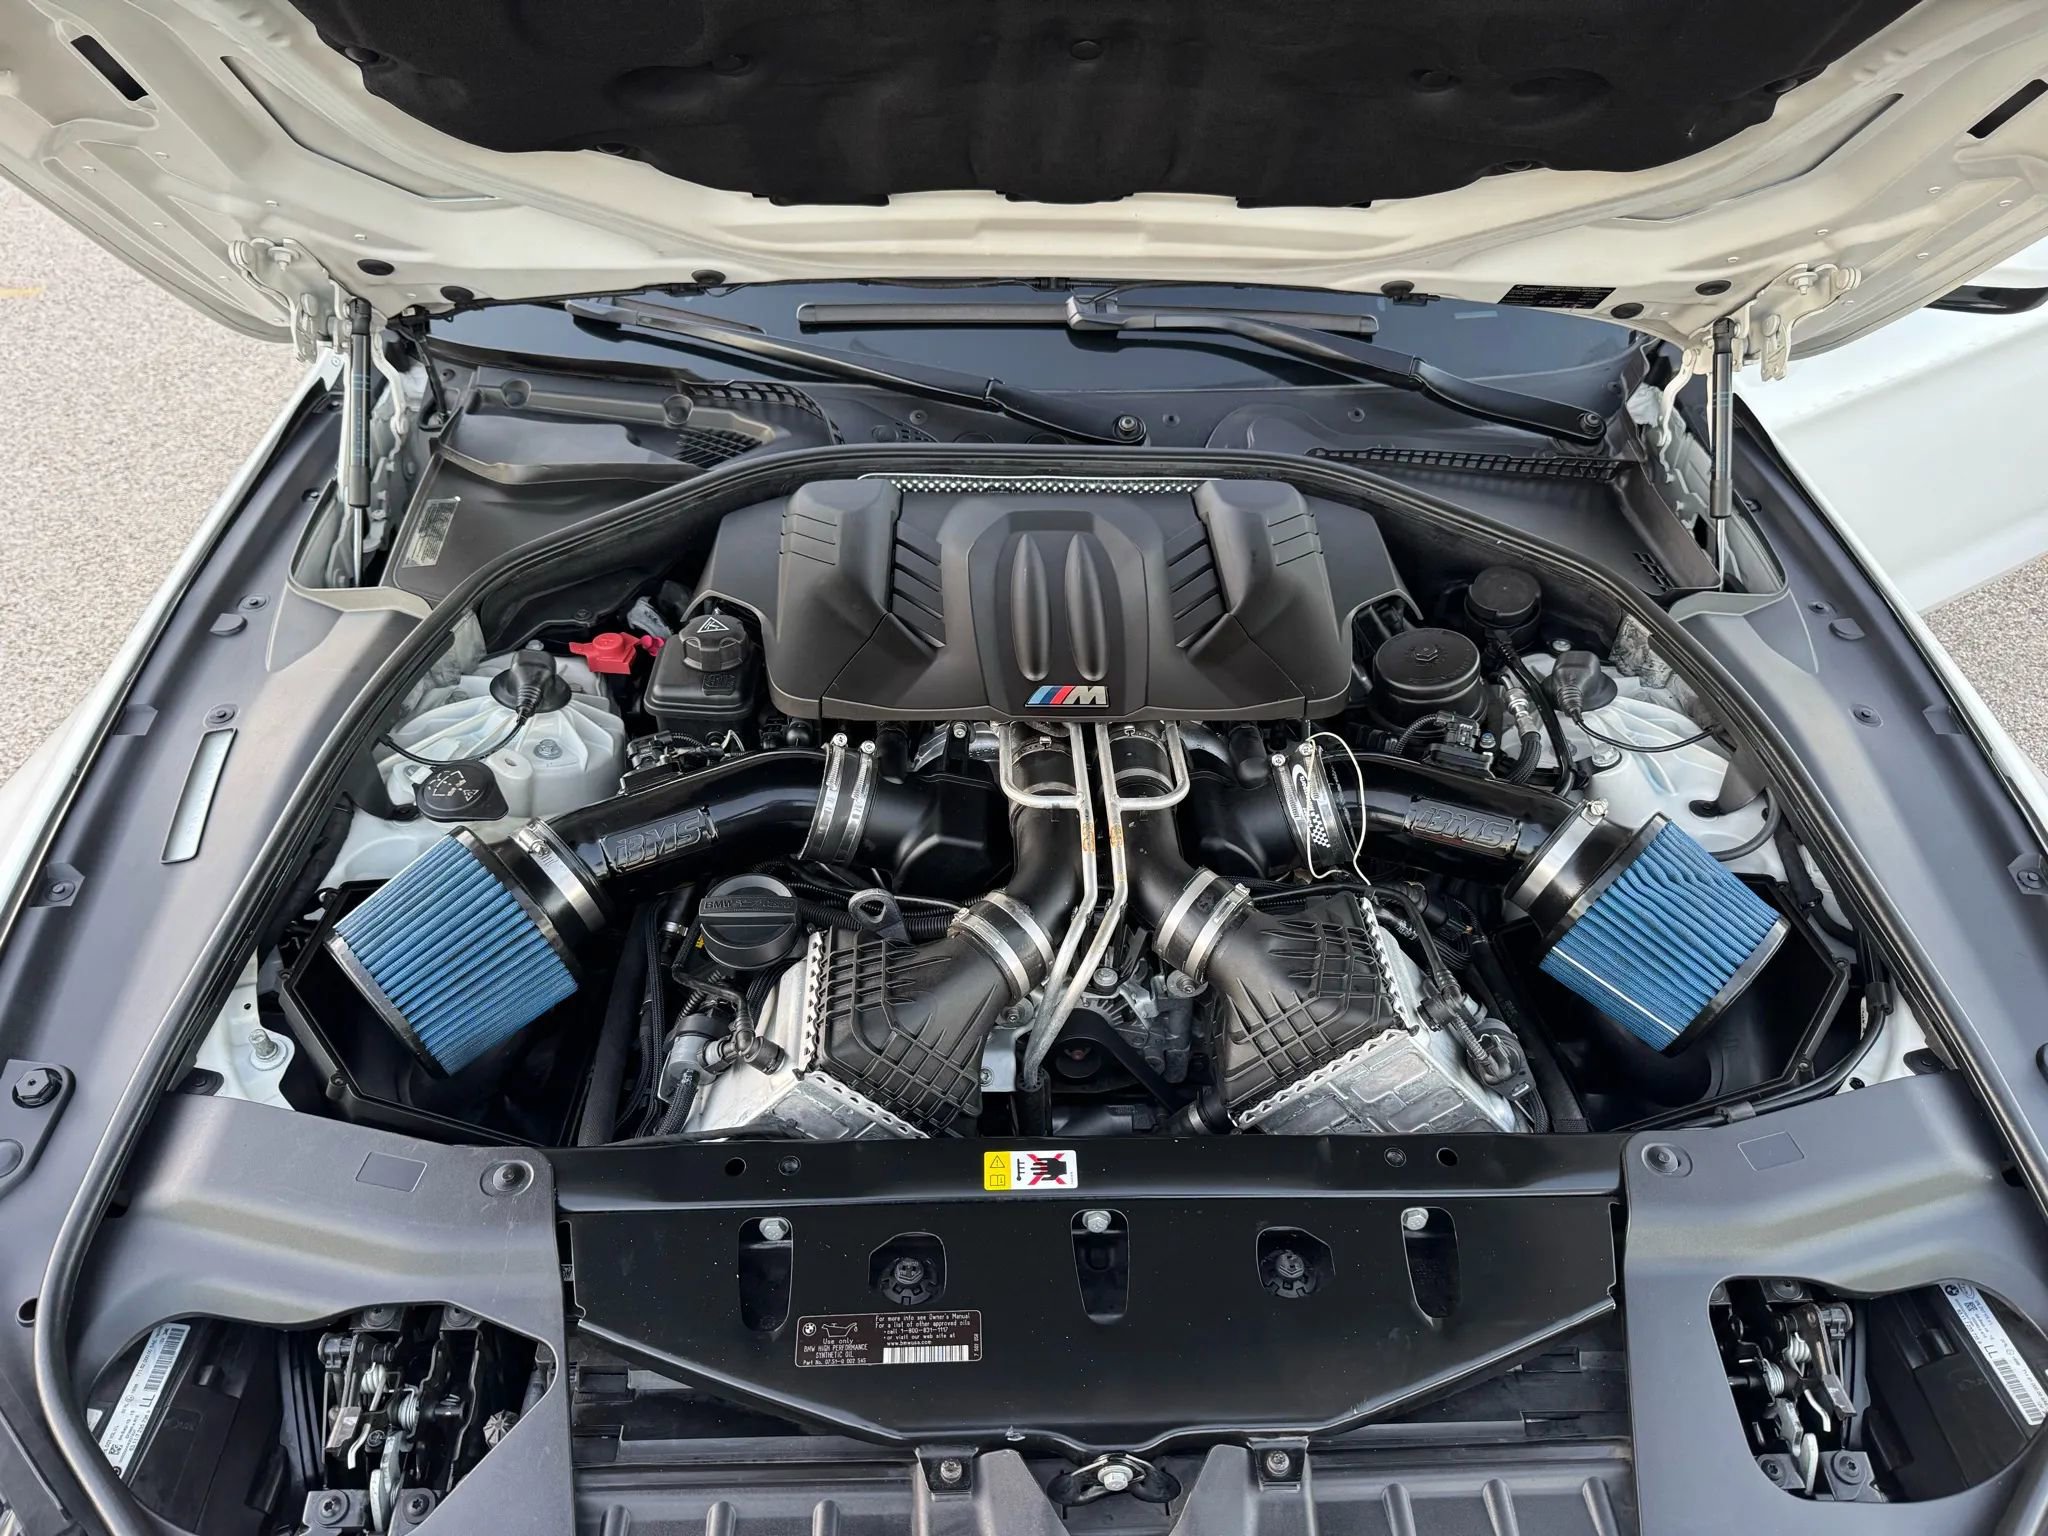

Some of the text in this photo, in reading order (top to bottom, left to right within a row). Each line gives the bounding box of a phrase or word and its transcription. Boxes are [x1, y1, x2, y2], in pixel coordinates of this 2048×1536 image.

[704, 900, 731, 911] BMW
[951, 1312, 970, 1320] Manual
[875, 1321, 885, 1329] For
[906, 1320, 913, 1328] of
[822, 1337, 854, 1345] Use only
[803, 1345, 816, 1353] BMW
[832, 1343, 868, 1351] PERFORMANCE
[815, 1350, 854, 1359] SYNTHETIC OIL
